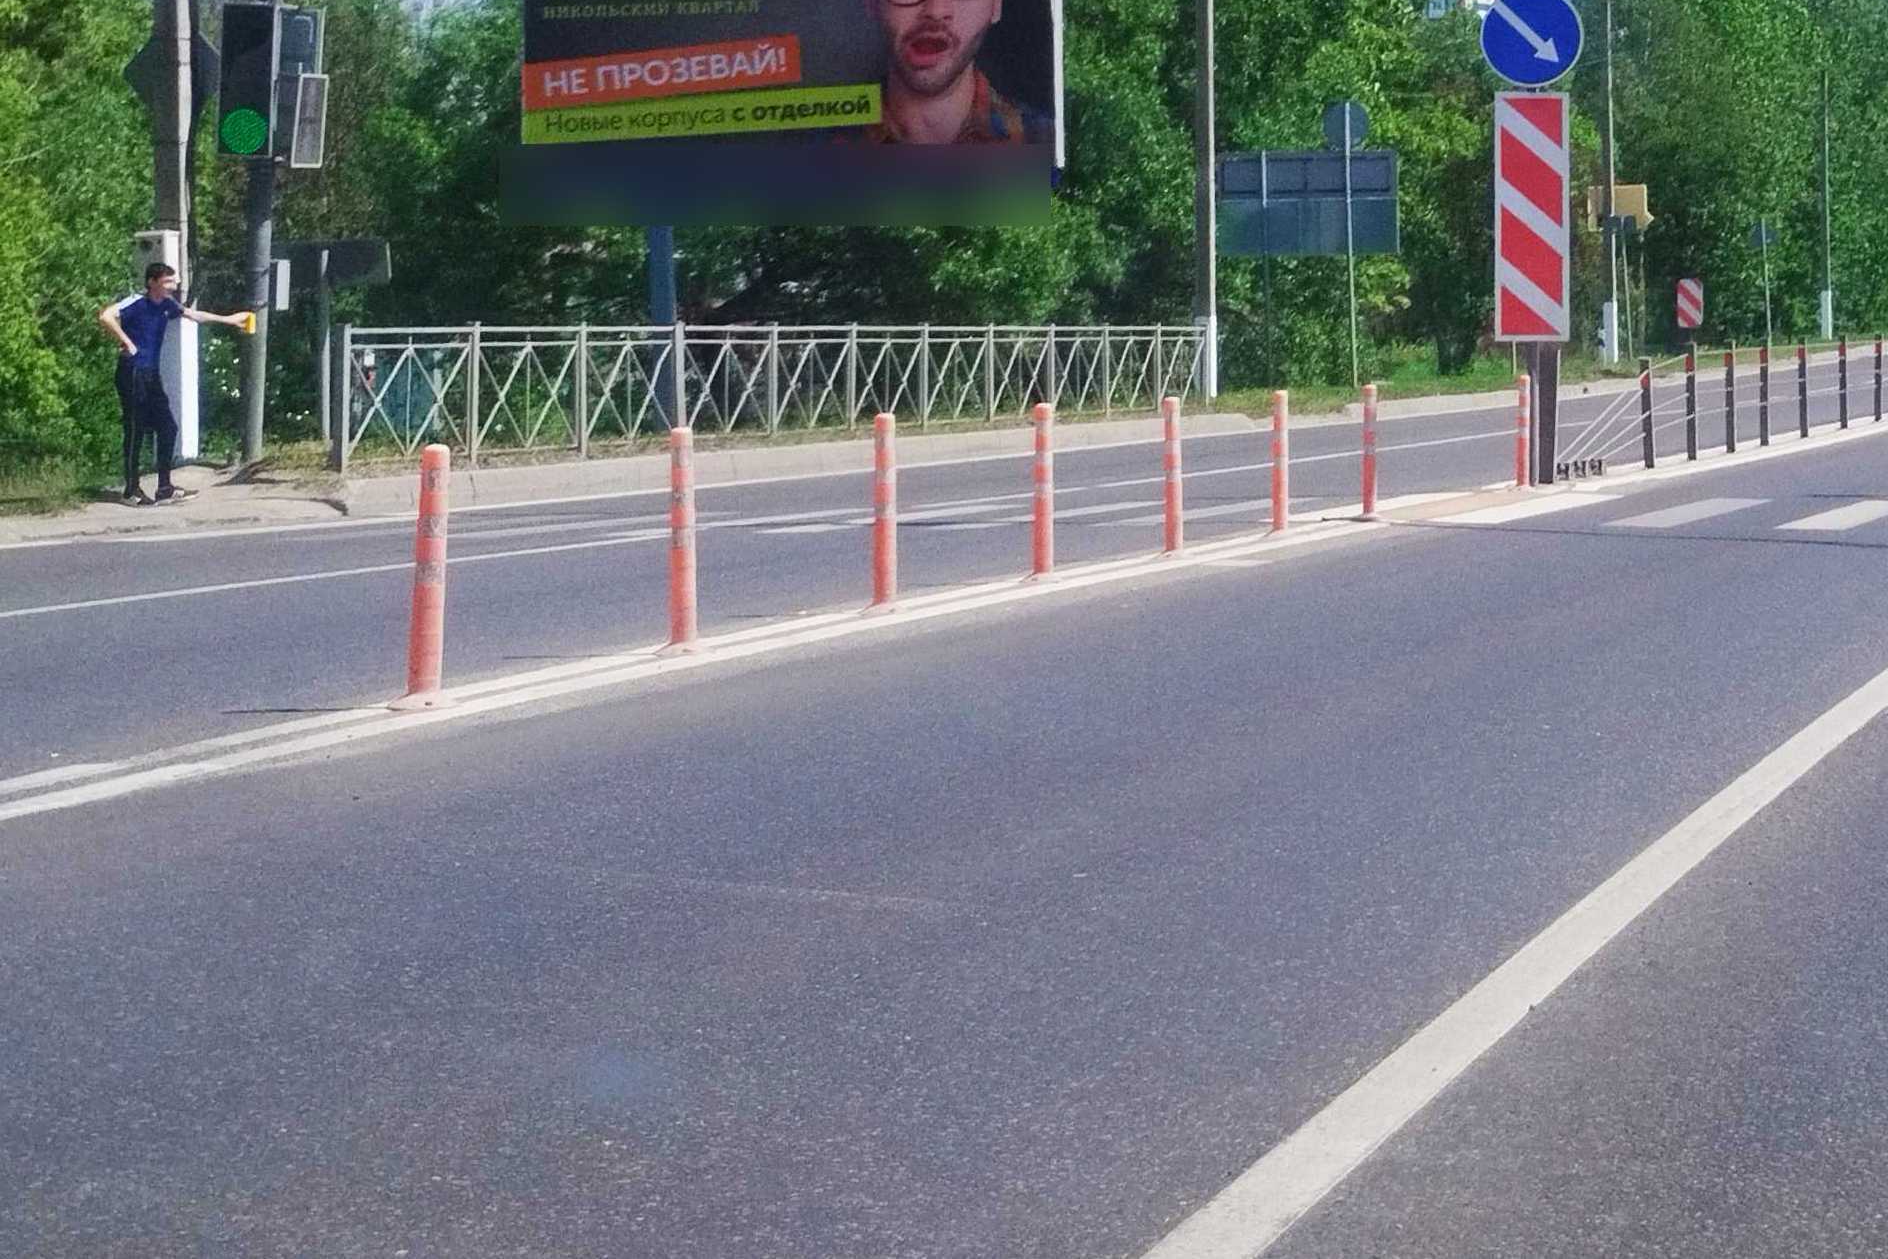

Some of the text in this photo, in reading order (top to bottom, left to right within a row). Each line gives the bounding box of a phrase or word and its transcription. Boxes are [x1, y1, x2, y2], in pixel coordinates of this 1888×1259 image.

[543, 0, 670, 19] НИКОЛЬСКИЙ
[543, 43, 787, 97] НЕ ПРОЗЕВАЙ!
[545, 95, 872, 134] Новые корпуса с отделкой
